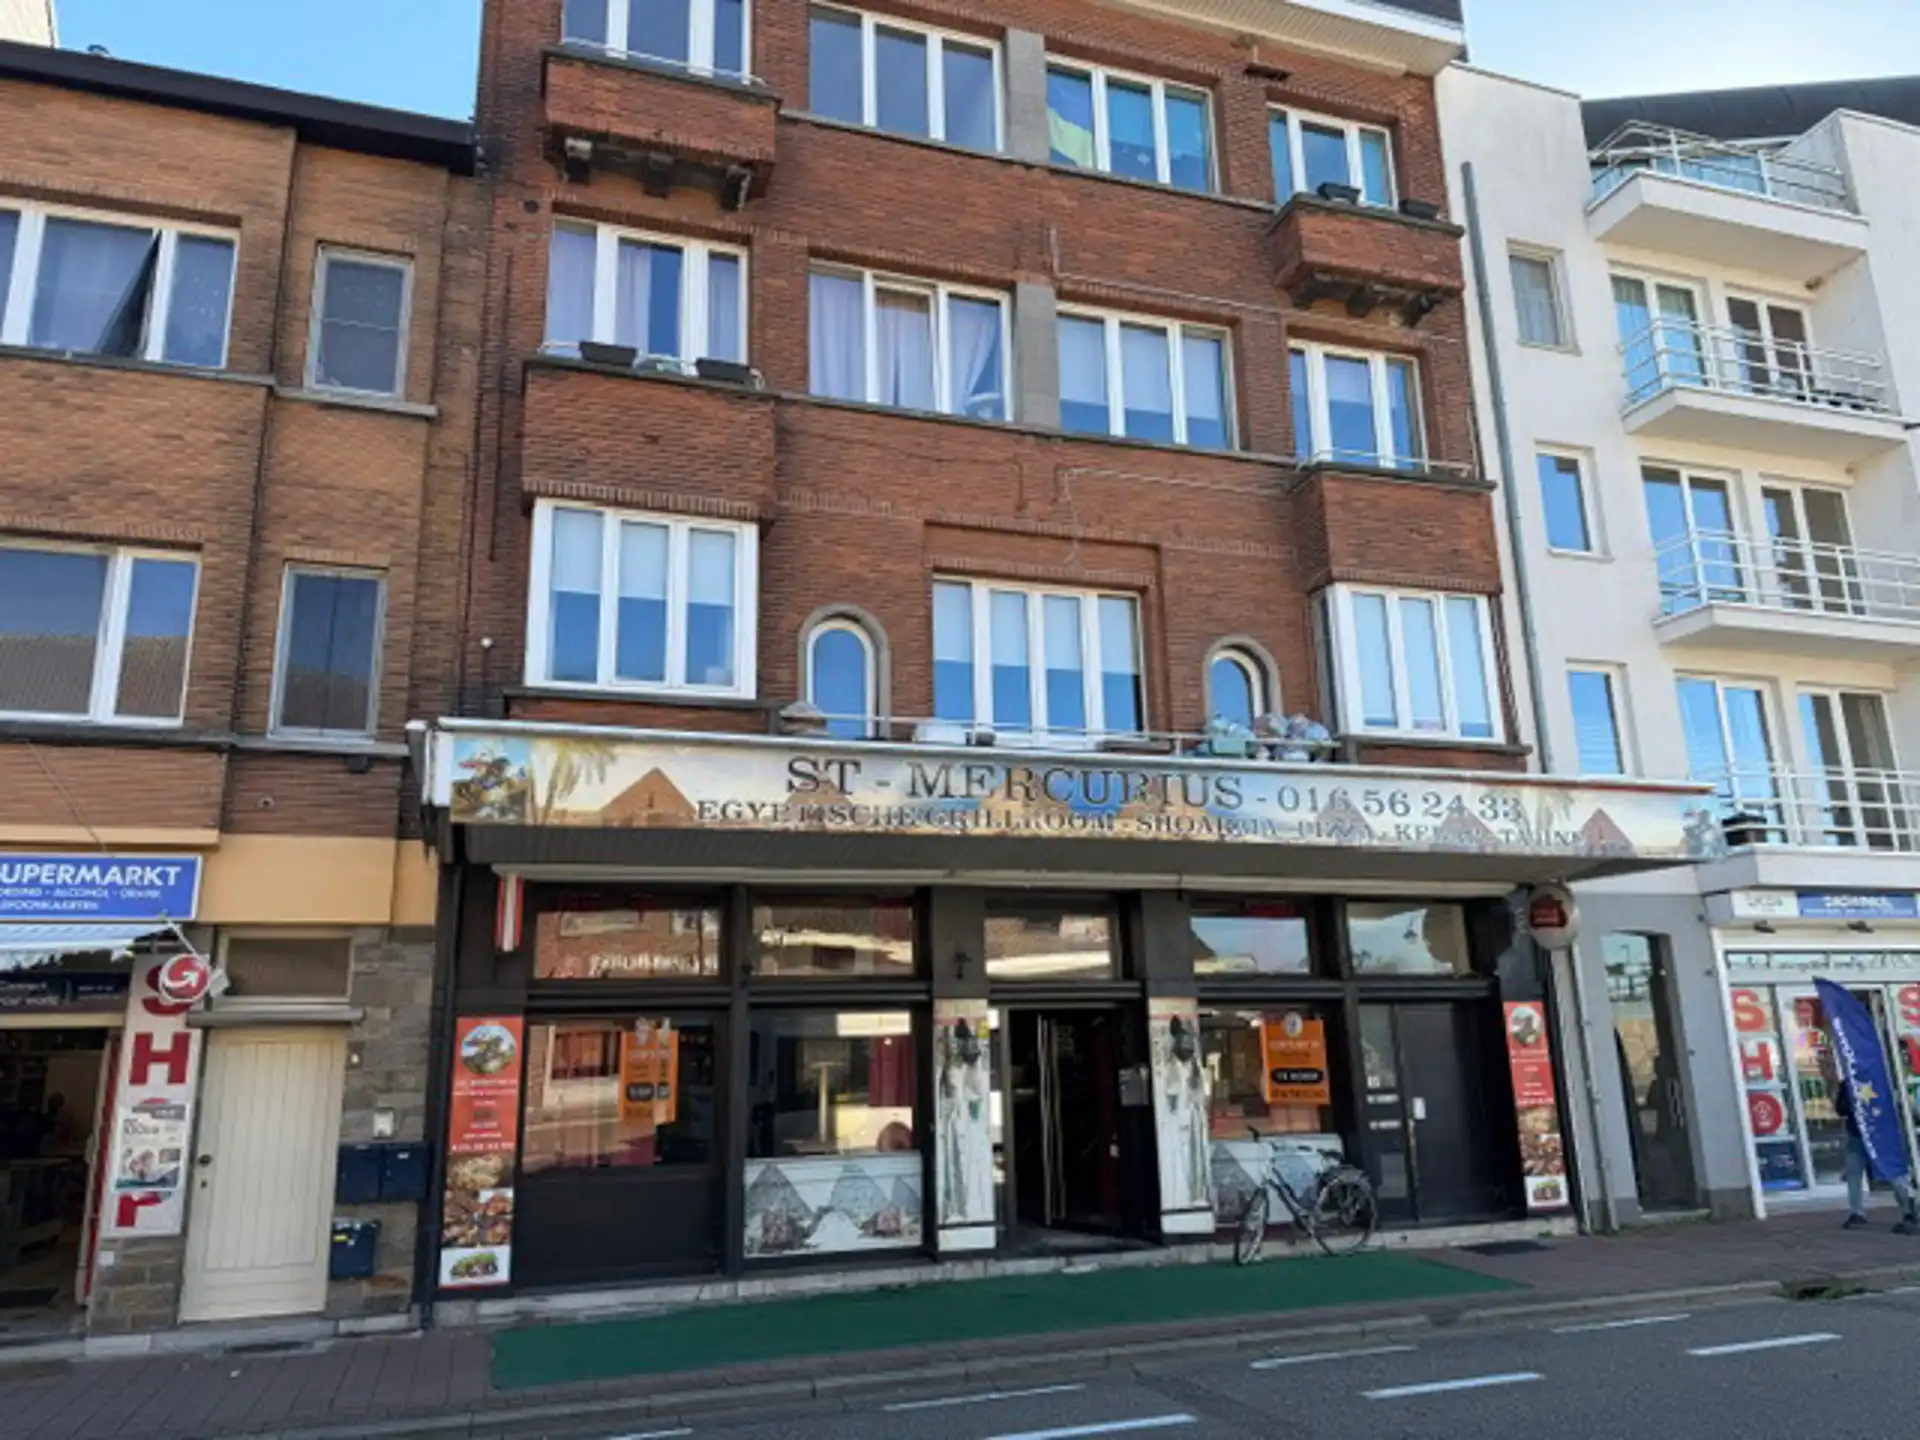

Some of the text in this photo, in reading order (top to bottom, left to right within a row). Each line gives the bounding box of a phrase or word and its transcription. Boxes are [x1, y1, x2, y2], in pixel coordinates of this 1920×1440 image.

[786, 756, 861, 795] ST
[907, 761, 1243, 810] MERCURIUS
[1277, 785, 1350, 813] 016
[1363, 789, 1411, 816] 56
[1422, 792, 1465, 818] 24
[0, 863, 181, 886] UPERMARKT
